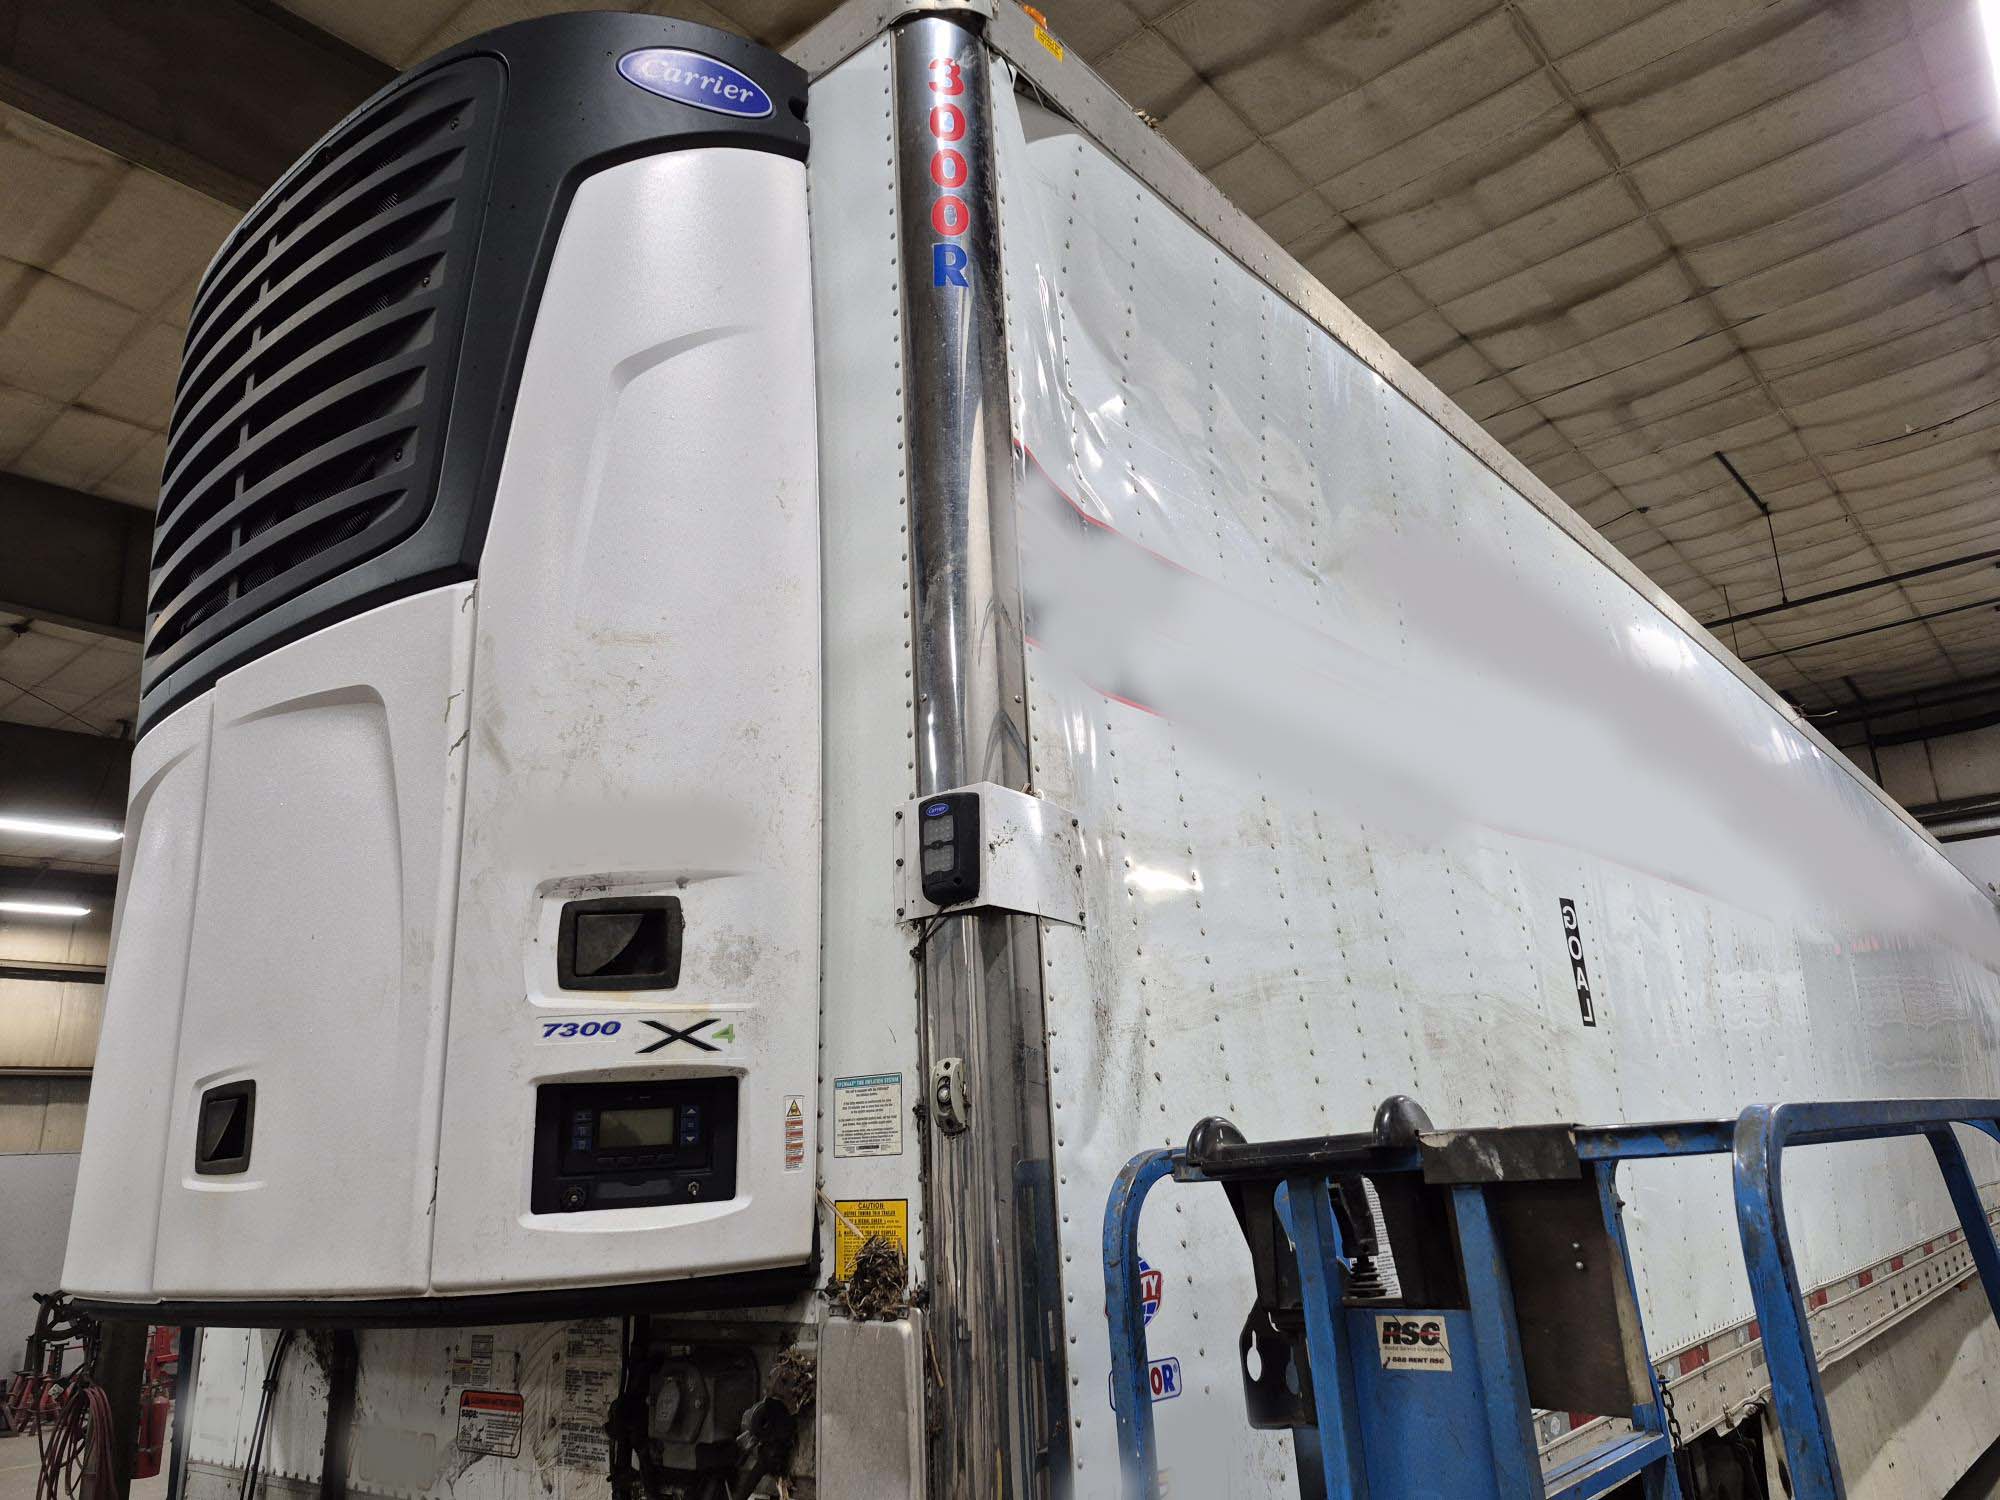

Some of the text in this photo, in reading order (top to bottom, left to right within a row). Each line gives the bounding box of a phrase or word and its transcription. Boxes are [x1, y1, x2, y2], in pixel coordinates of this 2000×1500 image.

[642, 58, 753, 103] Carrier
[928, 57, 970, 288] 3000R
[543, 1021, 622, 1038] 7300
[1383, 1321, 1440, 1346] RSC
